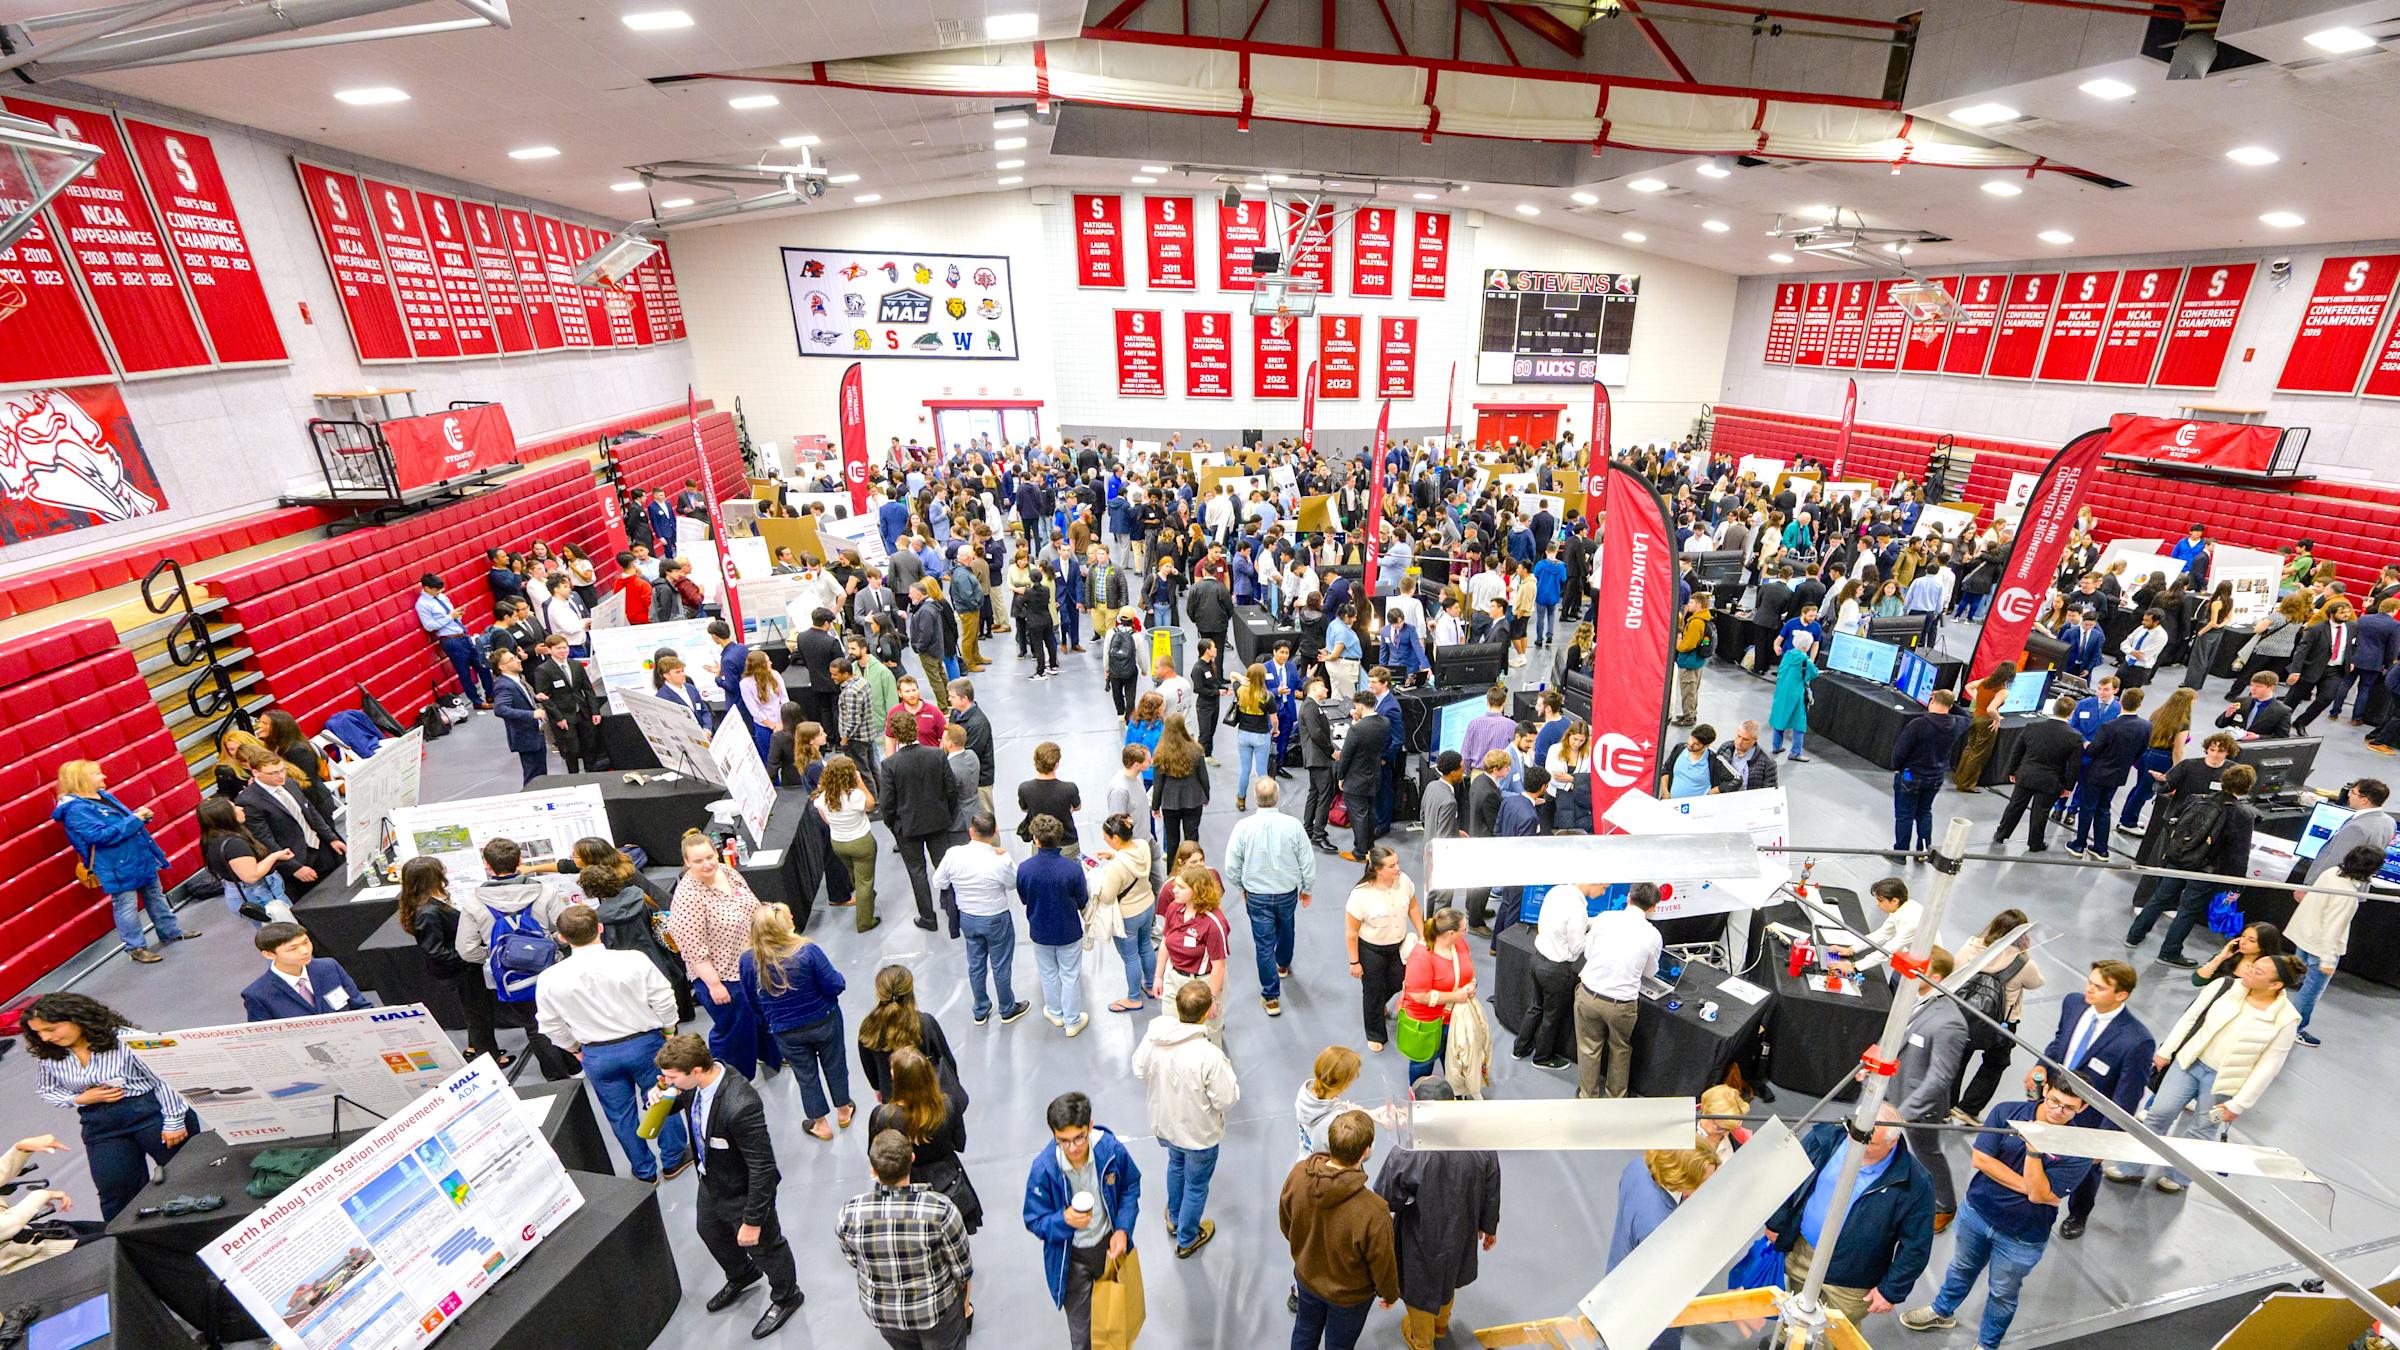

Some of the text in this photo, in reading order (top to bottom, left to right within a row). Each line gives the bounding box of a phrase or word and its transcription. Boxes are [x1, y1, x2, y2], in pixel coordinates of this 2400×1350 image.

[164, 136, 198, 193] S
[90, 188, 125, 201] HOCKEY
[325, 176, 348, 221] S
[174, 196, 218, 213] MEN'S GOLF
[385, 190, 405, 231] S
[1092, 198, 1104, 219] S
[1163, 201, 1176, 222] S
[1236, 203, 1249, 224] S
[80, 204, 131, 227] NCAA
[166, 211, 238, 235] CONFERENCE
[433, 200, 451, 238] S
[1370, 211, 1381, 231] S
[476, 208, 491, 244] S
[513, 215, 527, 248] S
[1427, 216, 1437, 235] S
[71, 227, 157, 247] APPEARANCES
[174, 231, 245, 253] CHAMPIONS
[545, 221, 558, 252] S
[574, 229, 585, 257] S
[1226, 233, 1259, 241] CHAMPION
[1359, 240, 1390, 248] CHAMPIONS
[1361, 233, 1388, 241] NATIONAL
[21, 247, 53, 263] 2010
[338, 239, 367, 257] NCAA
[387, 246, 429, 261] CONFERENCE
[80, 251, 165, 267] 2008 2009 2010
[184, 253, 251, 271] 2021 2022 2023
[333, 255, 381, 270] APPEARANCES
[391, 259, 433, 275] CHAMPIONS
[444, 253, 464, 267] NCAA
[1092, 262, 1110, 271] 2011
[1162, 264, 1181, 273] 2011
[31, 270, 64, 285] 2023
[91, 272, 174, 287] 2015 2021 2023
[191, 272, 216, 286] 2024
[1233, 267, 1252, 275] 2013
[1361, 274, 1385, 285] 2015
[2344, 261, 2370, 292] S
[1517, 271, 1611, 293] STEVENS
[1976, 279, 1990, 301] S
[2026, 278, 2041, 301] S
[2080, 275, 2097, 301] S
[2139, 273, 2159, 300] S
[2208, 269, 2228, 298] S
[1785, 286, 1794, 305] S
[1817, 286, 1827, 305] S
[1850, 285, 1860, 304] S
[881, 305, 928, 322] MAC
[2006, 311, 2047, 319] CONFERENCE
[2068, 311, 2091, 320] NCAA
[2127, 311, 2152, 320] NCAA
[2181, 309, 2236, 318] CONFERENCE
[2310, 305, 2380, 315] CONFERENCE
[1132, 313, 1145, 333] S
[1201, 315, 1214, 335] S
[1270, 317, 1282, 337] S
[1335, 319, 1346, 337] S
[1394, 321, 1404, 340] S
[2003, 319, 2045, 327] CHAMPIONS
[2177, 318, 2233, 327] CHAMPIONS
[2306, 316, 2376, 326] CHAMPIONS
[886, 330, 899, 349] S
[953, 332, 973, 350] W
[2302, 328, 2322, 336] 2019
[1514, 360, 1596, 377] GO DUCKS GO
[1266, 375, 1286, 383] 2022
[1327, 379, 1352, 389] 2023
[2161, 445, 2201, 454] innovation
[2044, 467, 2082, 544] ELECTRICAL AND
[2017, 466, 2071, 579] COMPUTER ENGINEERING
[1625, 532, 1649, 630] LAUNCHPAD
[371, 1009, 425, 1023] HALL
[181, 1014, 364, 1041] Hoboken Ferry Restoration
[449, 1070, 480, 1094] HALL
[457, 1083, 480, 1102] ADA
[229, 1126, 287, 1138] STEVENS
[221, 1096, 446, 1256] Perth Amboy Train Station Improvements
[240, 1236, 289, 1274] PROJECT OVERVIEW
